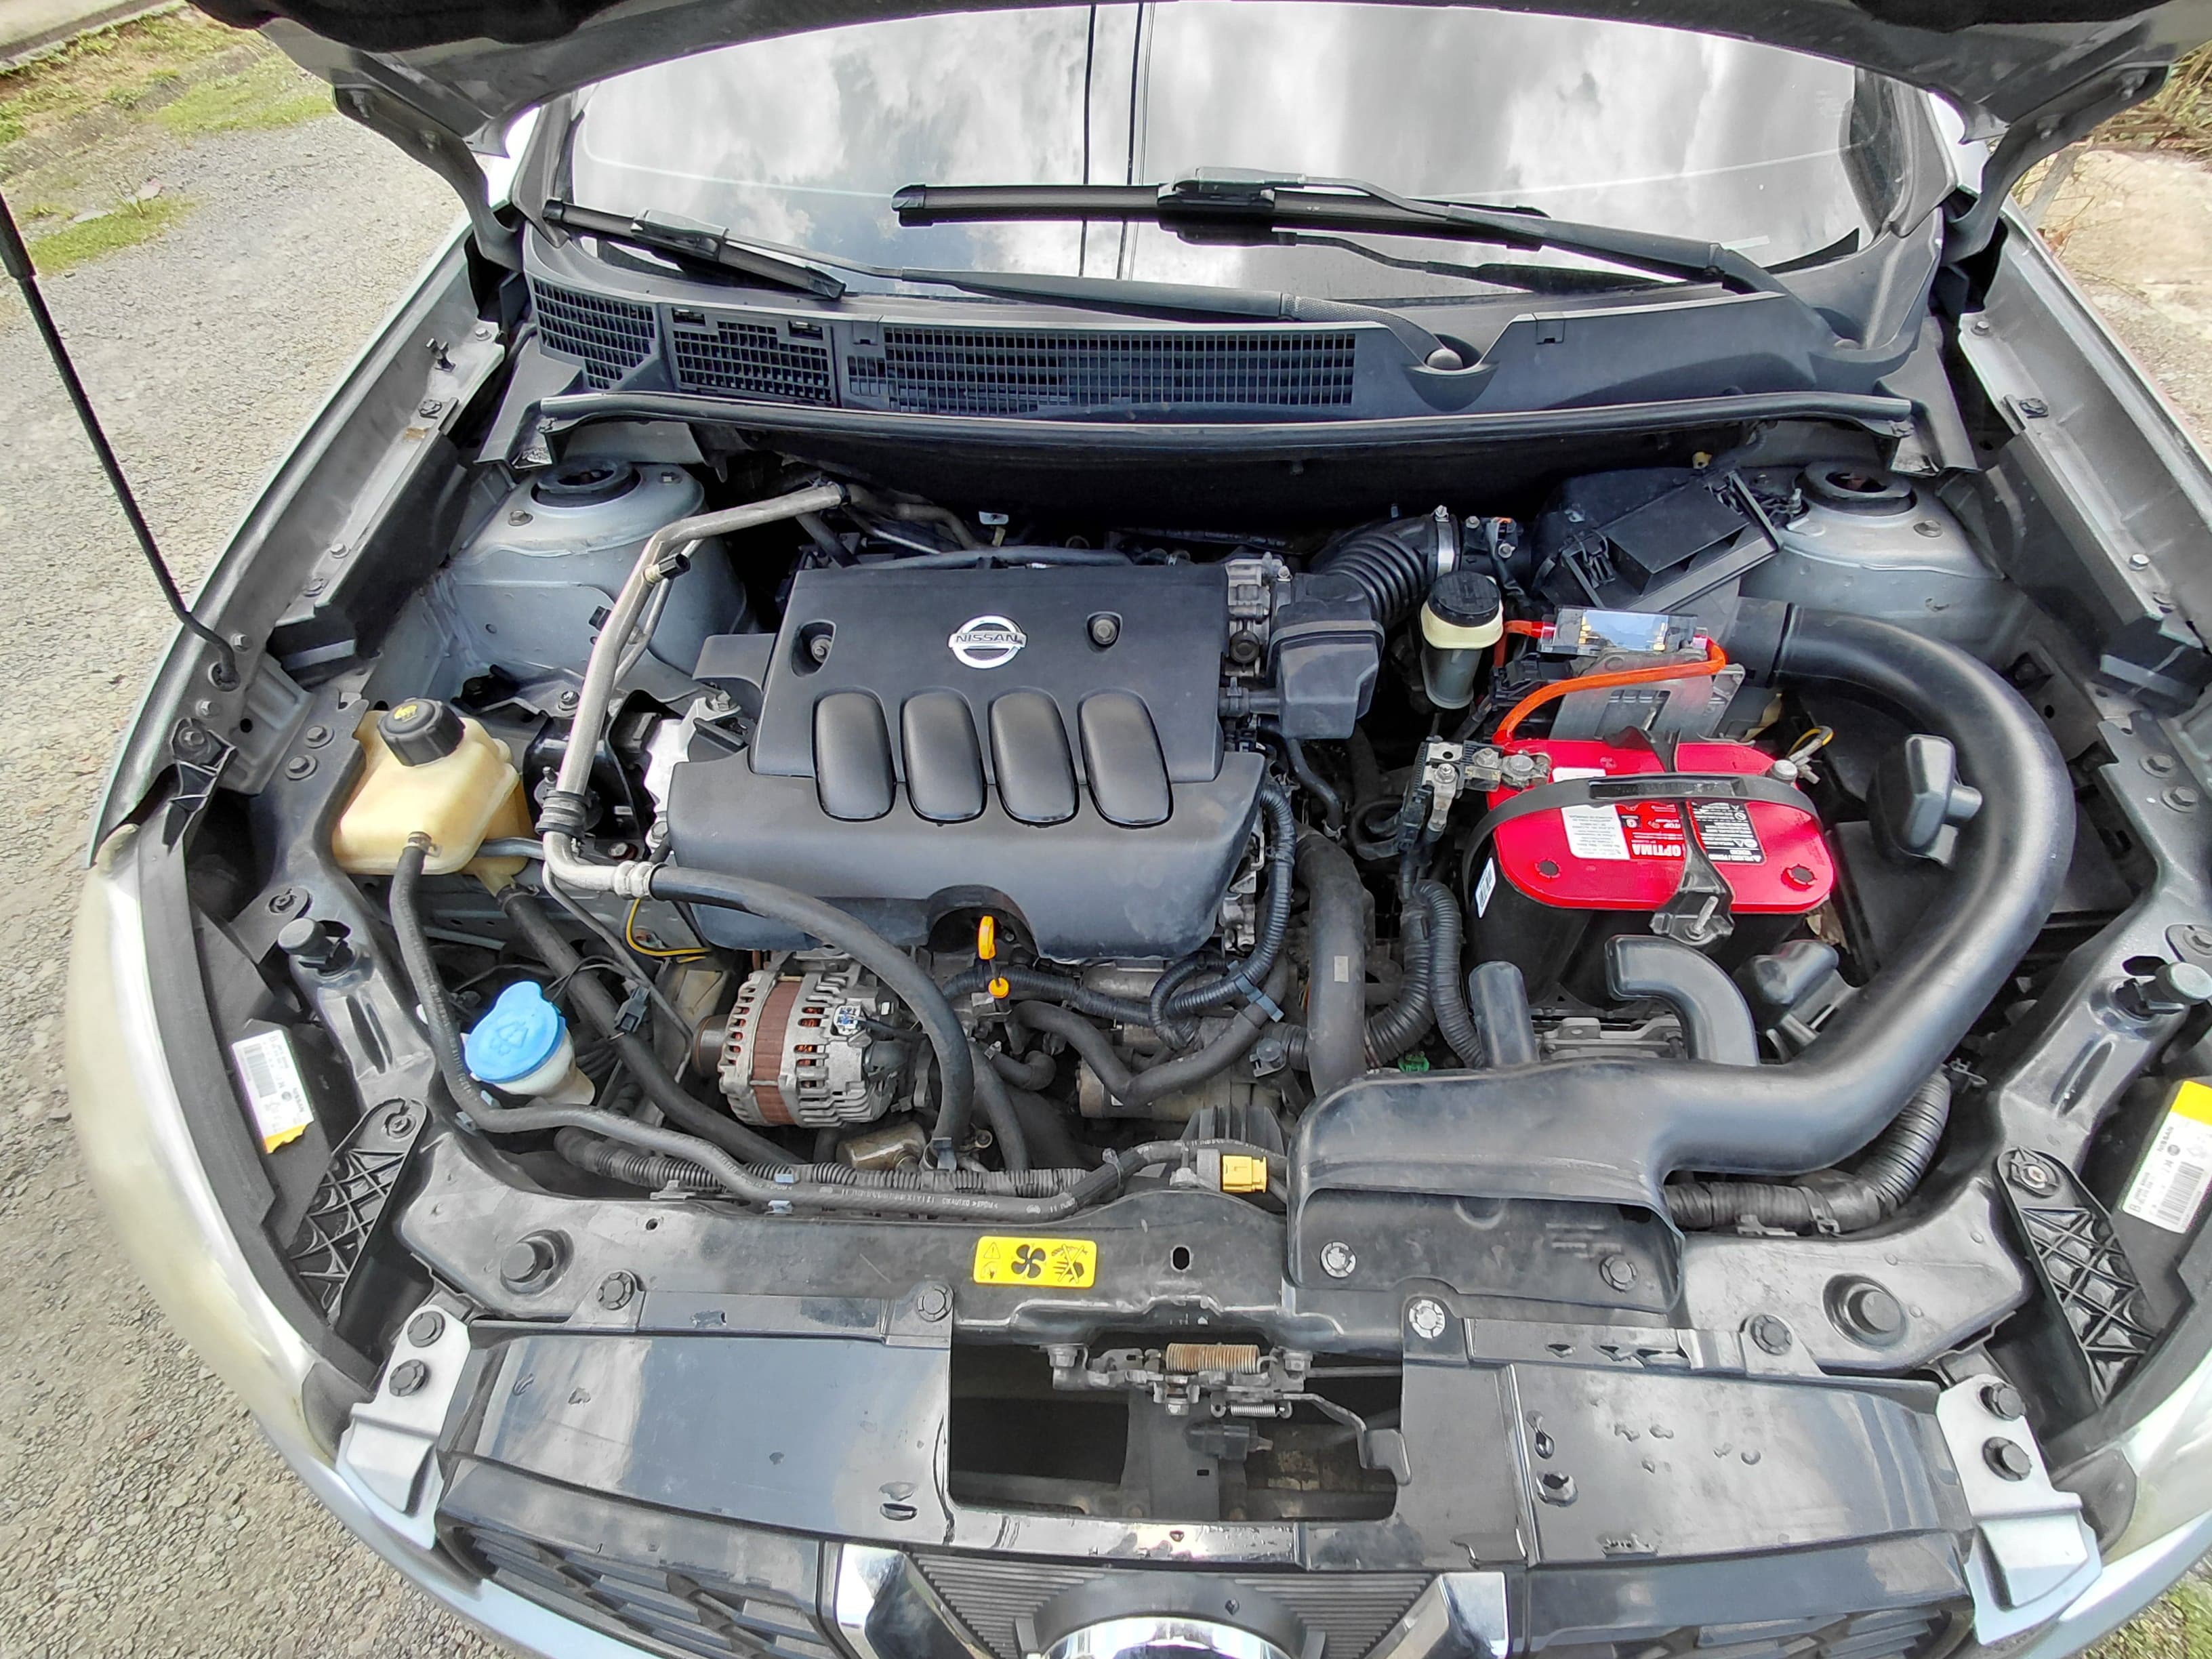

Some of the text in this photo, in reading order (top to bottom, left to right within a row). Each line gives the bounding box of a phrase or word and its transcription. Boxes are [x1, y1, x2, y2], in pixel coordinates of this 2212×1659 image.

[956, 634, 1018, 642] NISSAN
[1632, 844, 1681, 857] OPTIMA
[2157, 1126, 2175, 1152] NISSAN
